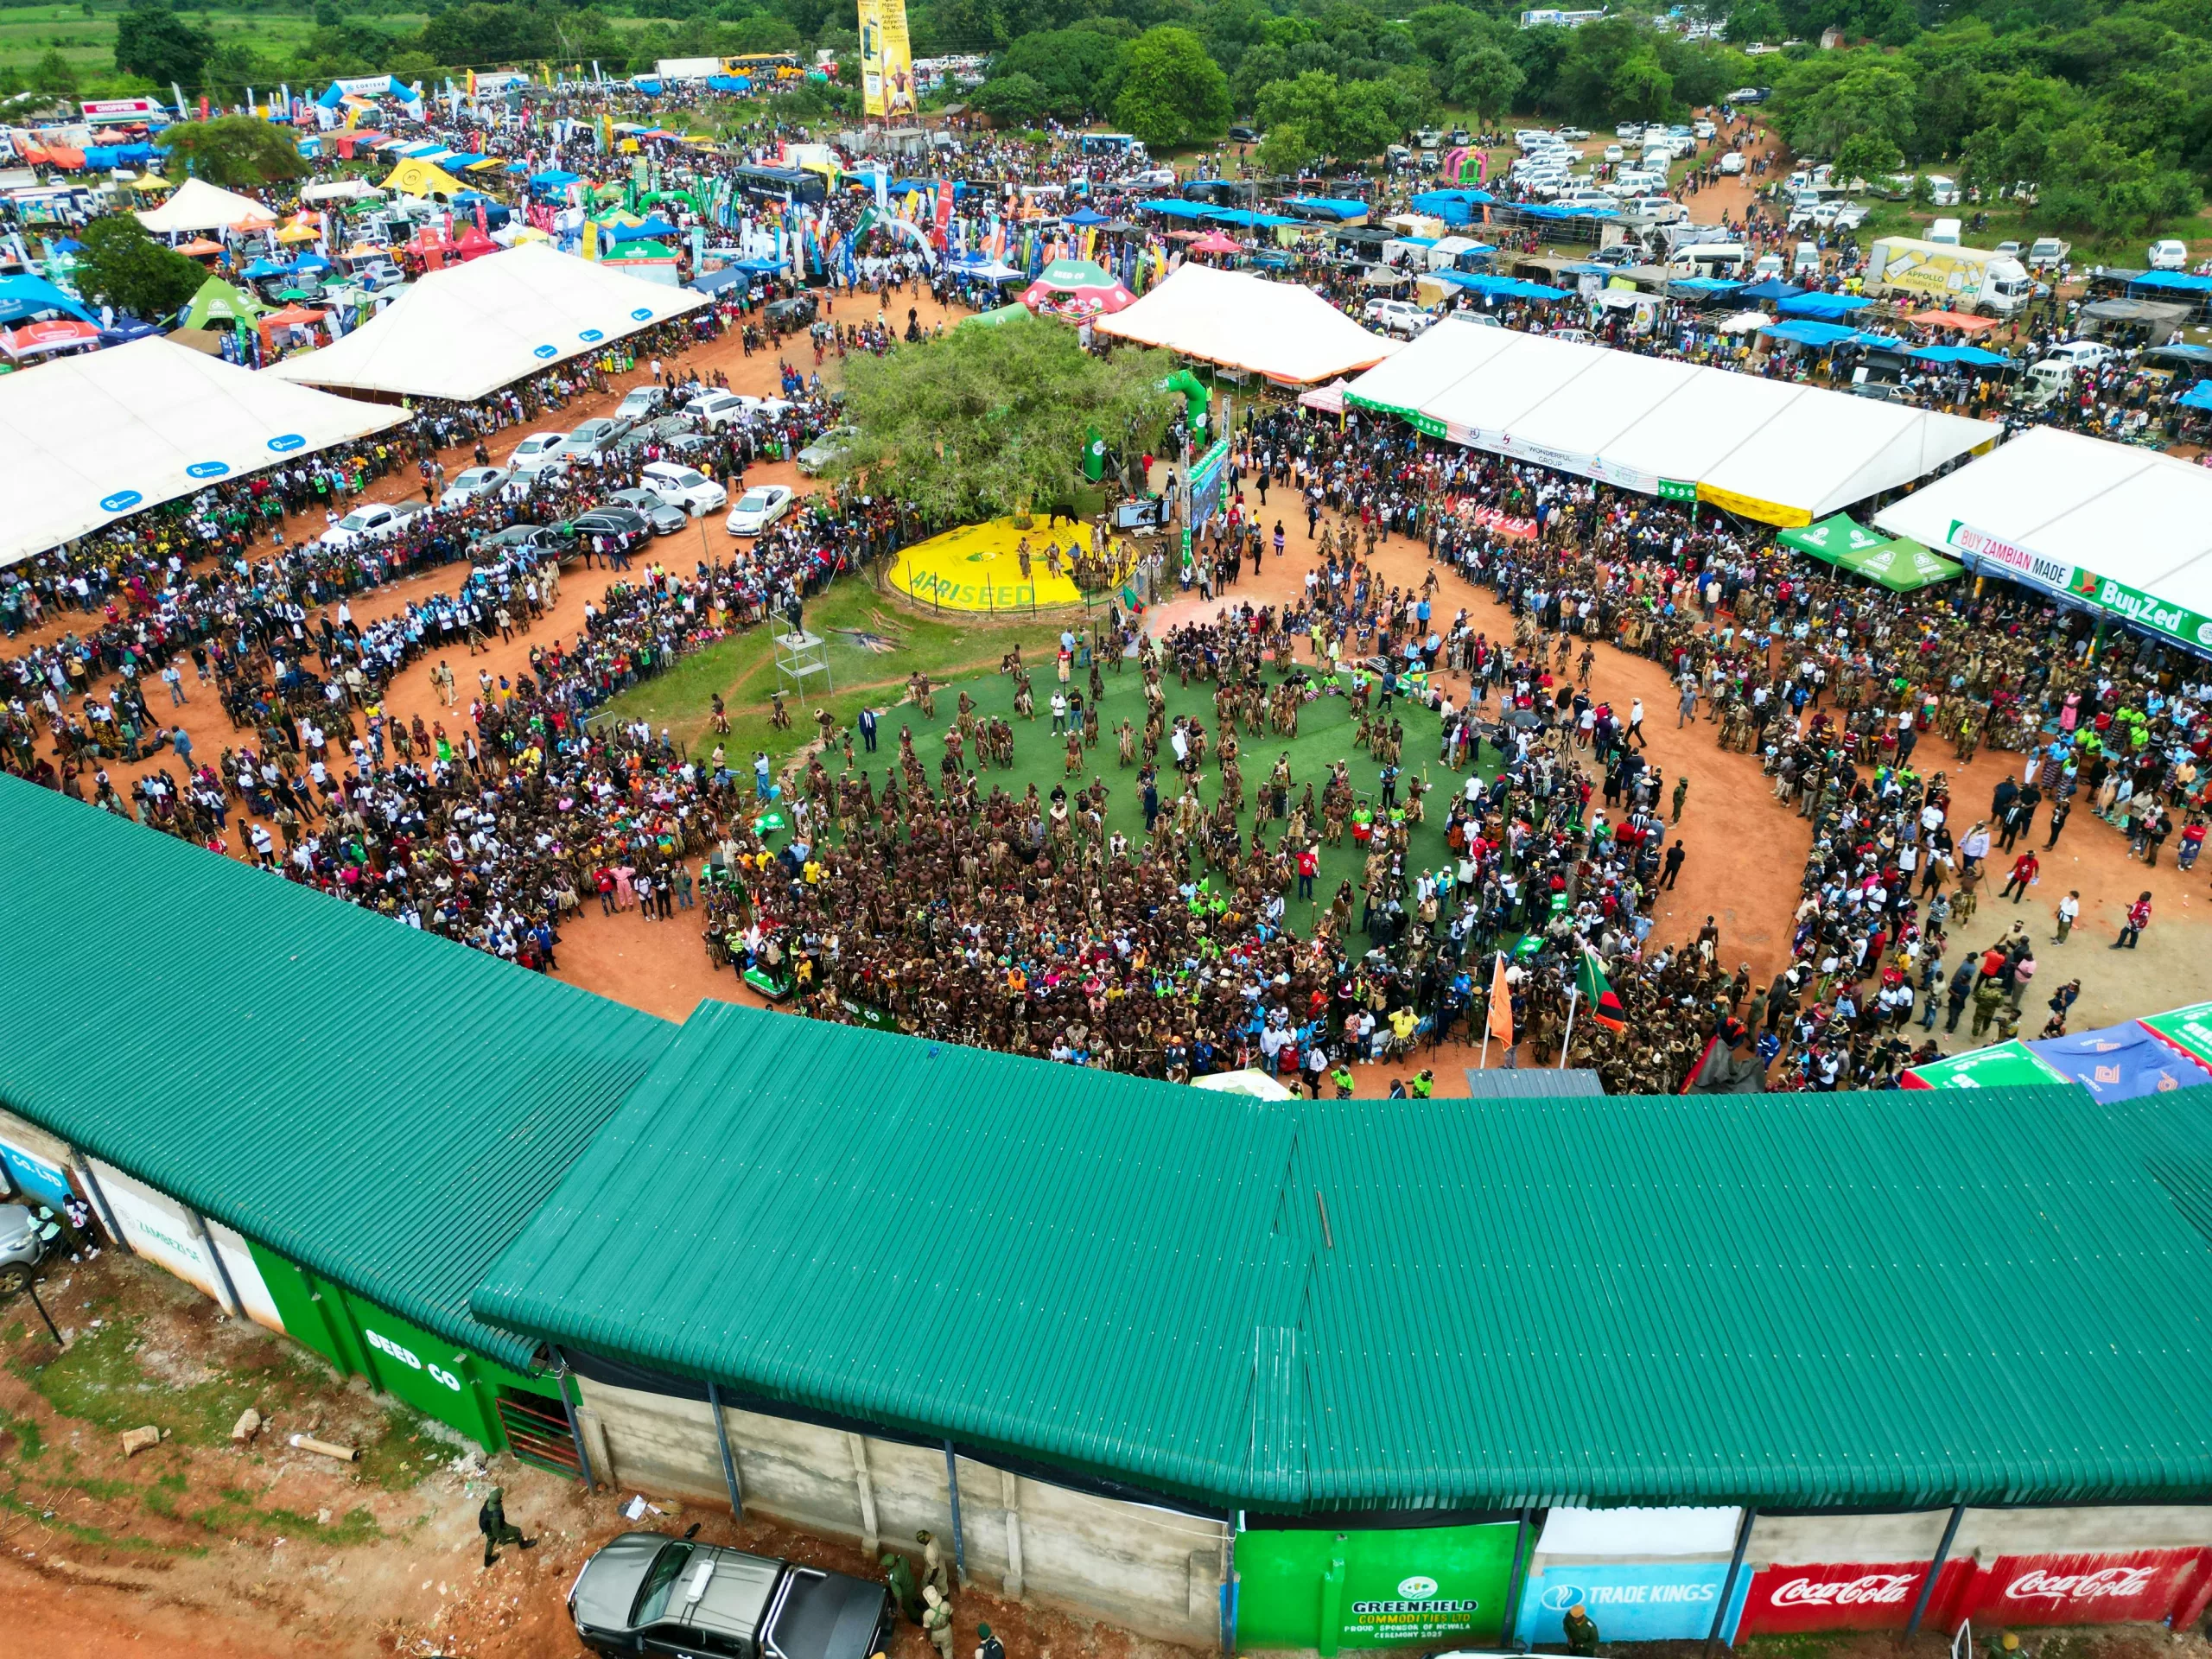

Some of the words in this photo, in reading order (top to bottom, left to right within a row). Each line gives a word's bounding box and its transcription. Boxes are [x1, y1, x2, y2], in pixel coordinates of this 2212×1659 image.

[1907, 270, 1944, 282] APPOLLO
[1529, 446, 1573, 462] WONDERFUL
[1539, 456, 1562, 467] GROUP
[1961, 530, 1983, 549] BUY
[1982, 538, 2032, 571] ZAMBIAN
[2031, 557, 2066, 584] MADE
[912, 570, 1033, 606] AFRISEED
[137, 1219, 188, 1255] ZAMBEZI
[365, 1329, 422, 1370] SEED
[428, 1363, 461, 1391] CO
[1589, 1585, 1648, 1605] TRADE
[1649, 1583, 1717, 1603] KINGS
[1770, 1573, 1921, 1607] Coca-Cola
[2005, 1566, 2160, 1599] Coca-Cola
[1352, 1599, 1478, 1613] GREENFIELD
[1358, 1614, 1448, 1624] COMMODITIES
[1452, 1613, 1471, 1623] LTD
